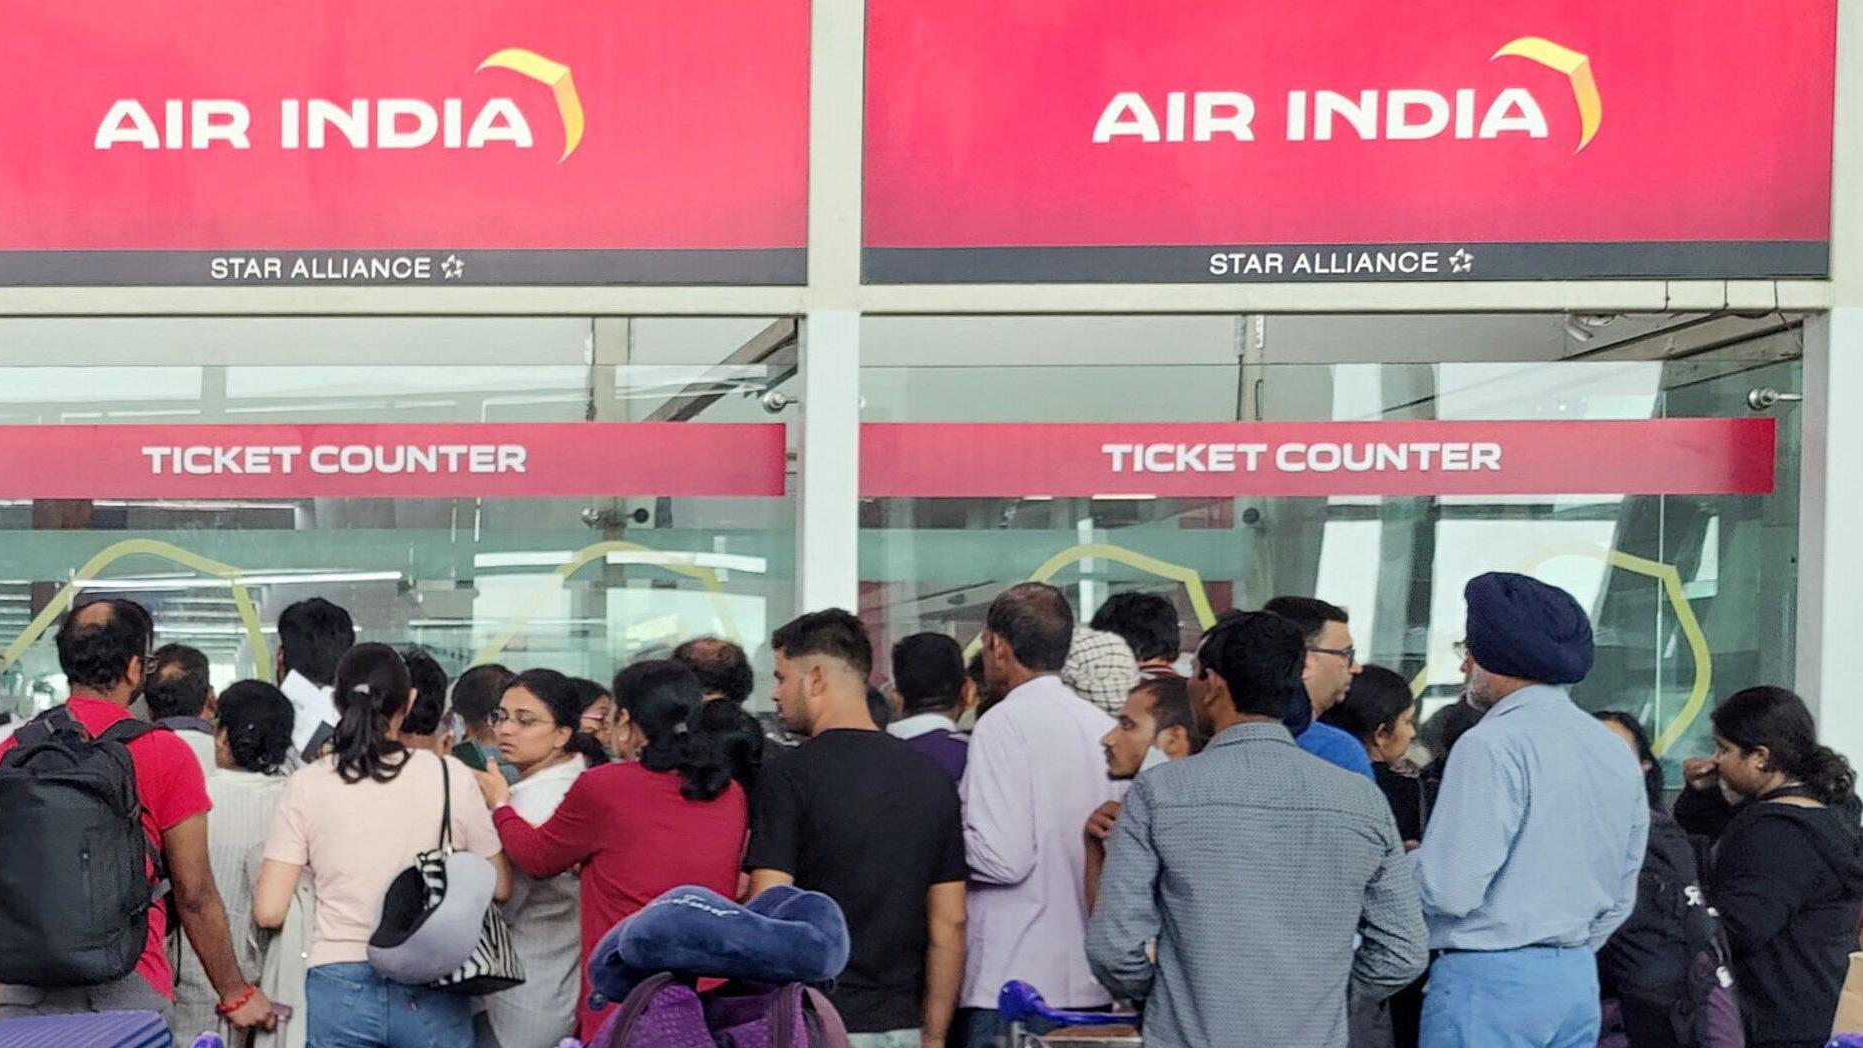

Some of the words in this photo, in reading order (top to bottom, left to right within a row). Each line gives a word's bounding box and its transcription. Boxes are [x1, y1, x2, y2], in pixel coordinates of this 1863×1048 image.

[94, 99, 251, 150] AIR
[281, 98, 534, 149] INDIA
[1092, 92, 1256, 143] AIR
[1286, 88, 1549, 141] INDIA
[210, 257, 282, 279] STAR
[290, 257, 431, 279] ALLIANCE
[1209, 253, 1284, 275] STAR
[1292, 251, 1439, 275] ALLIANCE
[141, 446, 302, 475] TICKET
[309, 445, 527, 474] COUNTER
[1101, 443, 1268, 472] TICKET
[1275, 442, 1502, 471] COUNTER
